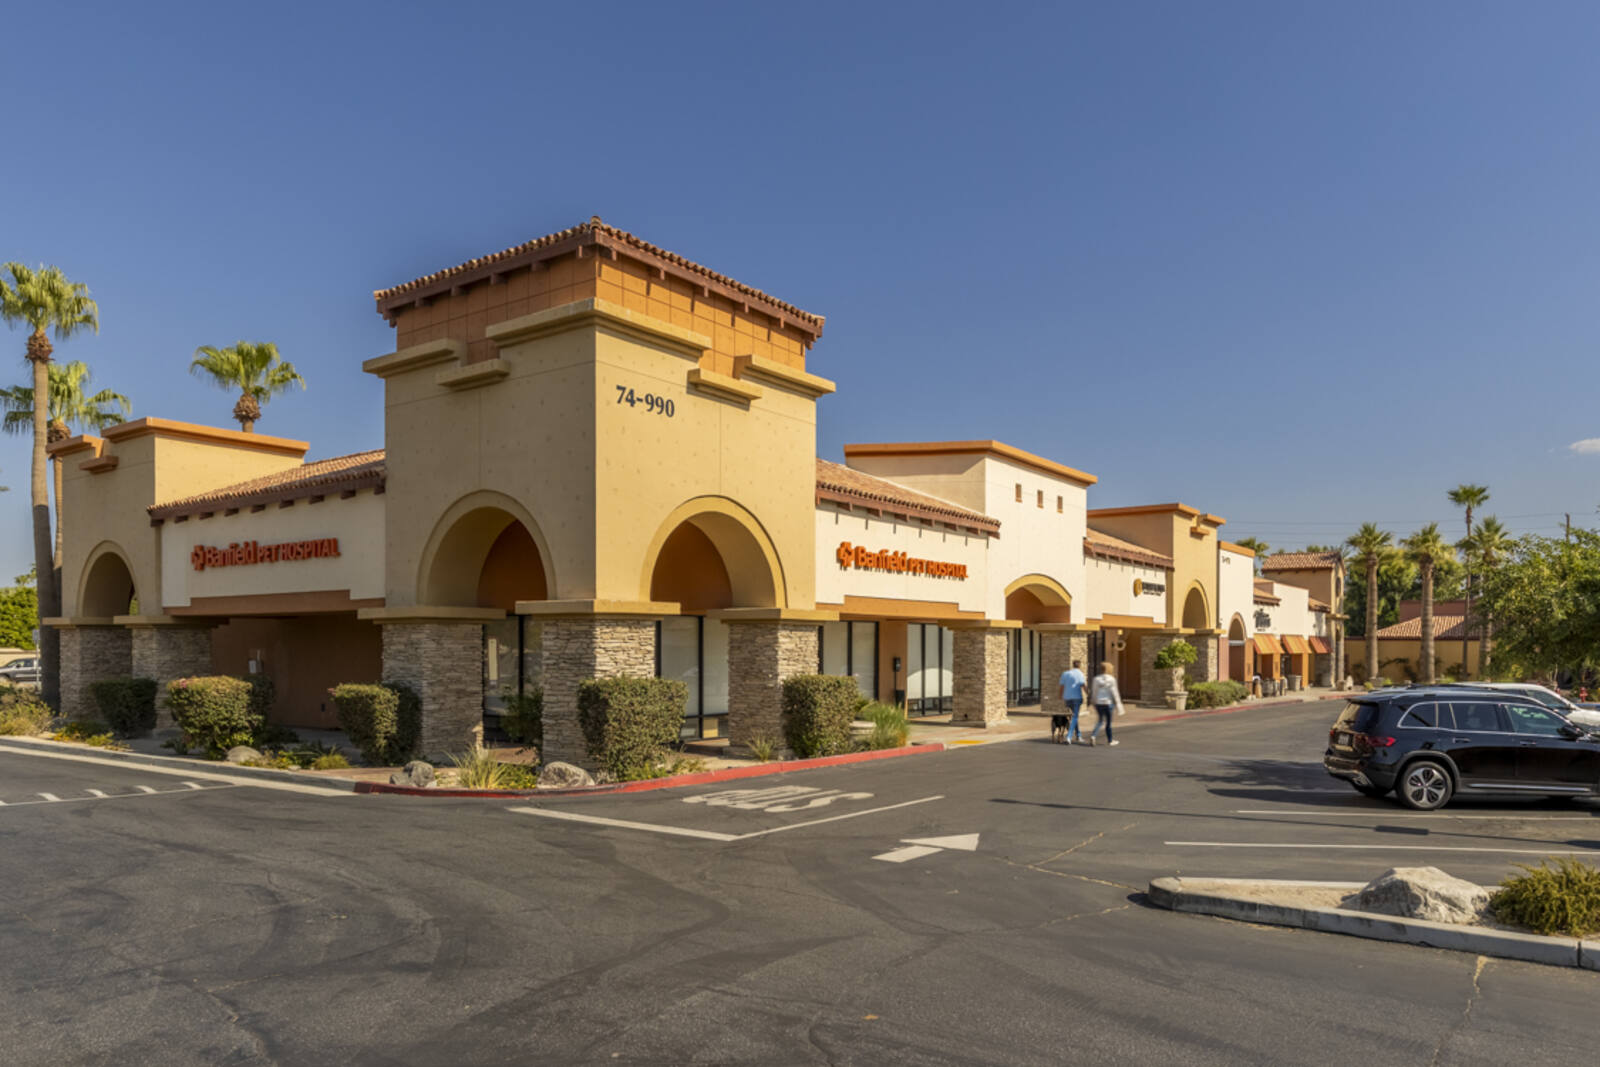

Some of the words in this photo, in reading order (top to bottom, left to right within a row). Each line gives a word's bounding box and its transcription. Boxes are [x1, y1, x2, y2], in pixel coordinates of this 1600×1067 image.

[615, 384, 675, 418] 74-990
[206, 540, 257, 568] Banfield
[257, 544, 280, 563] PET
[279, 537, 341, 561] HOSPITAL
[854, 546, 907, 572] Banfield
[925, 560, 968, 579] HOSPITAL
